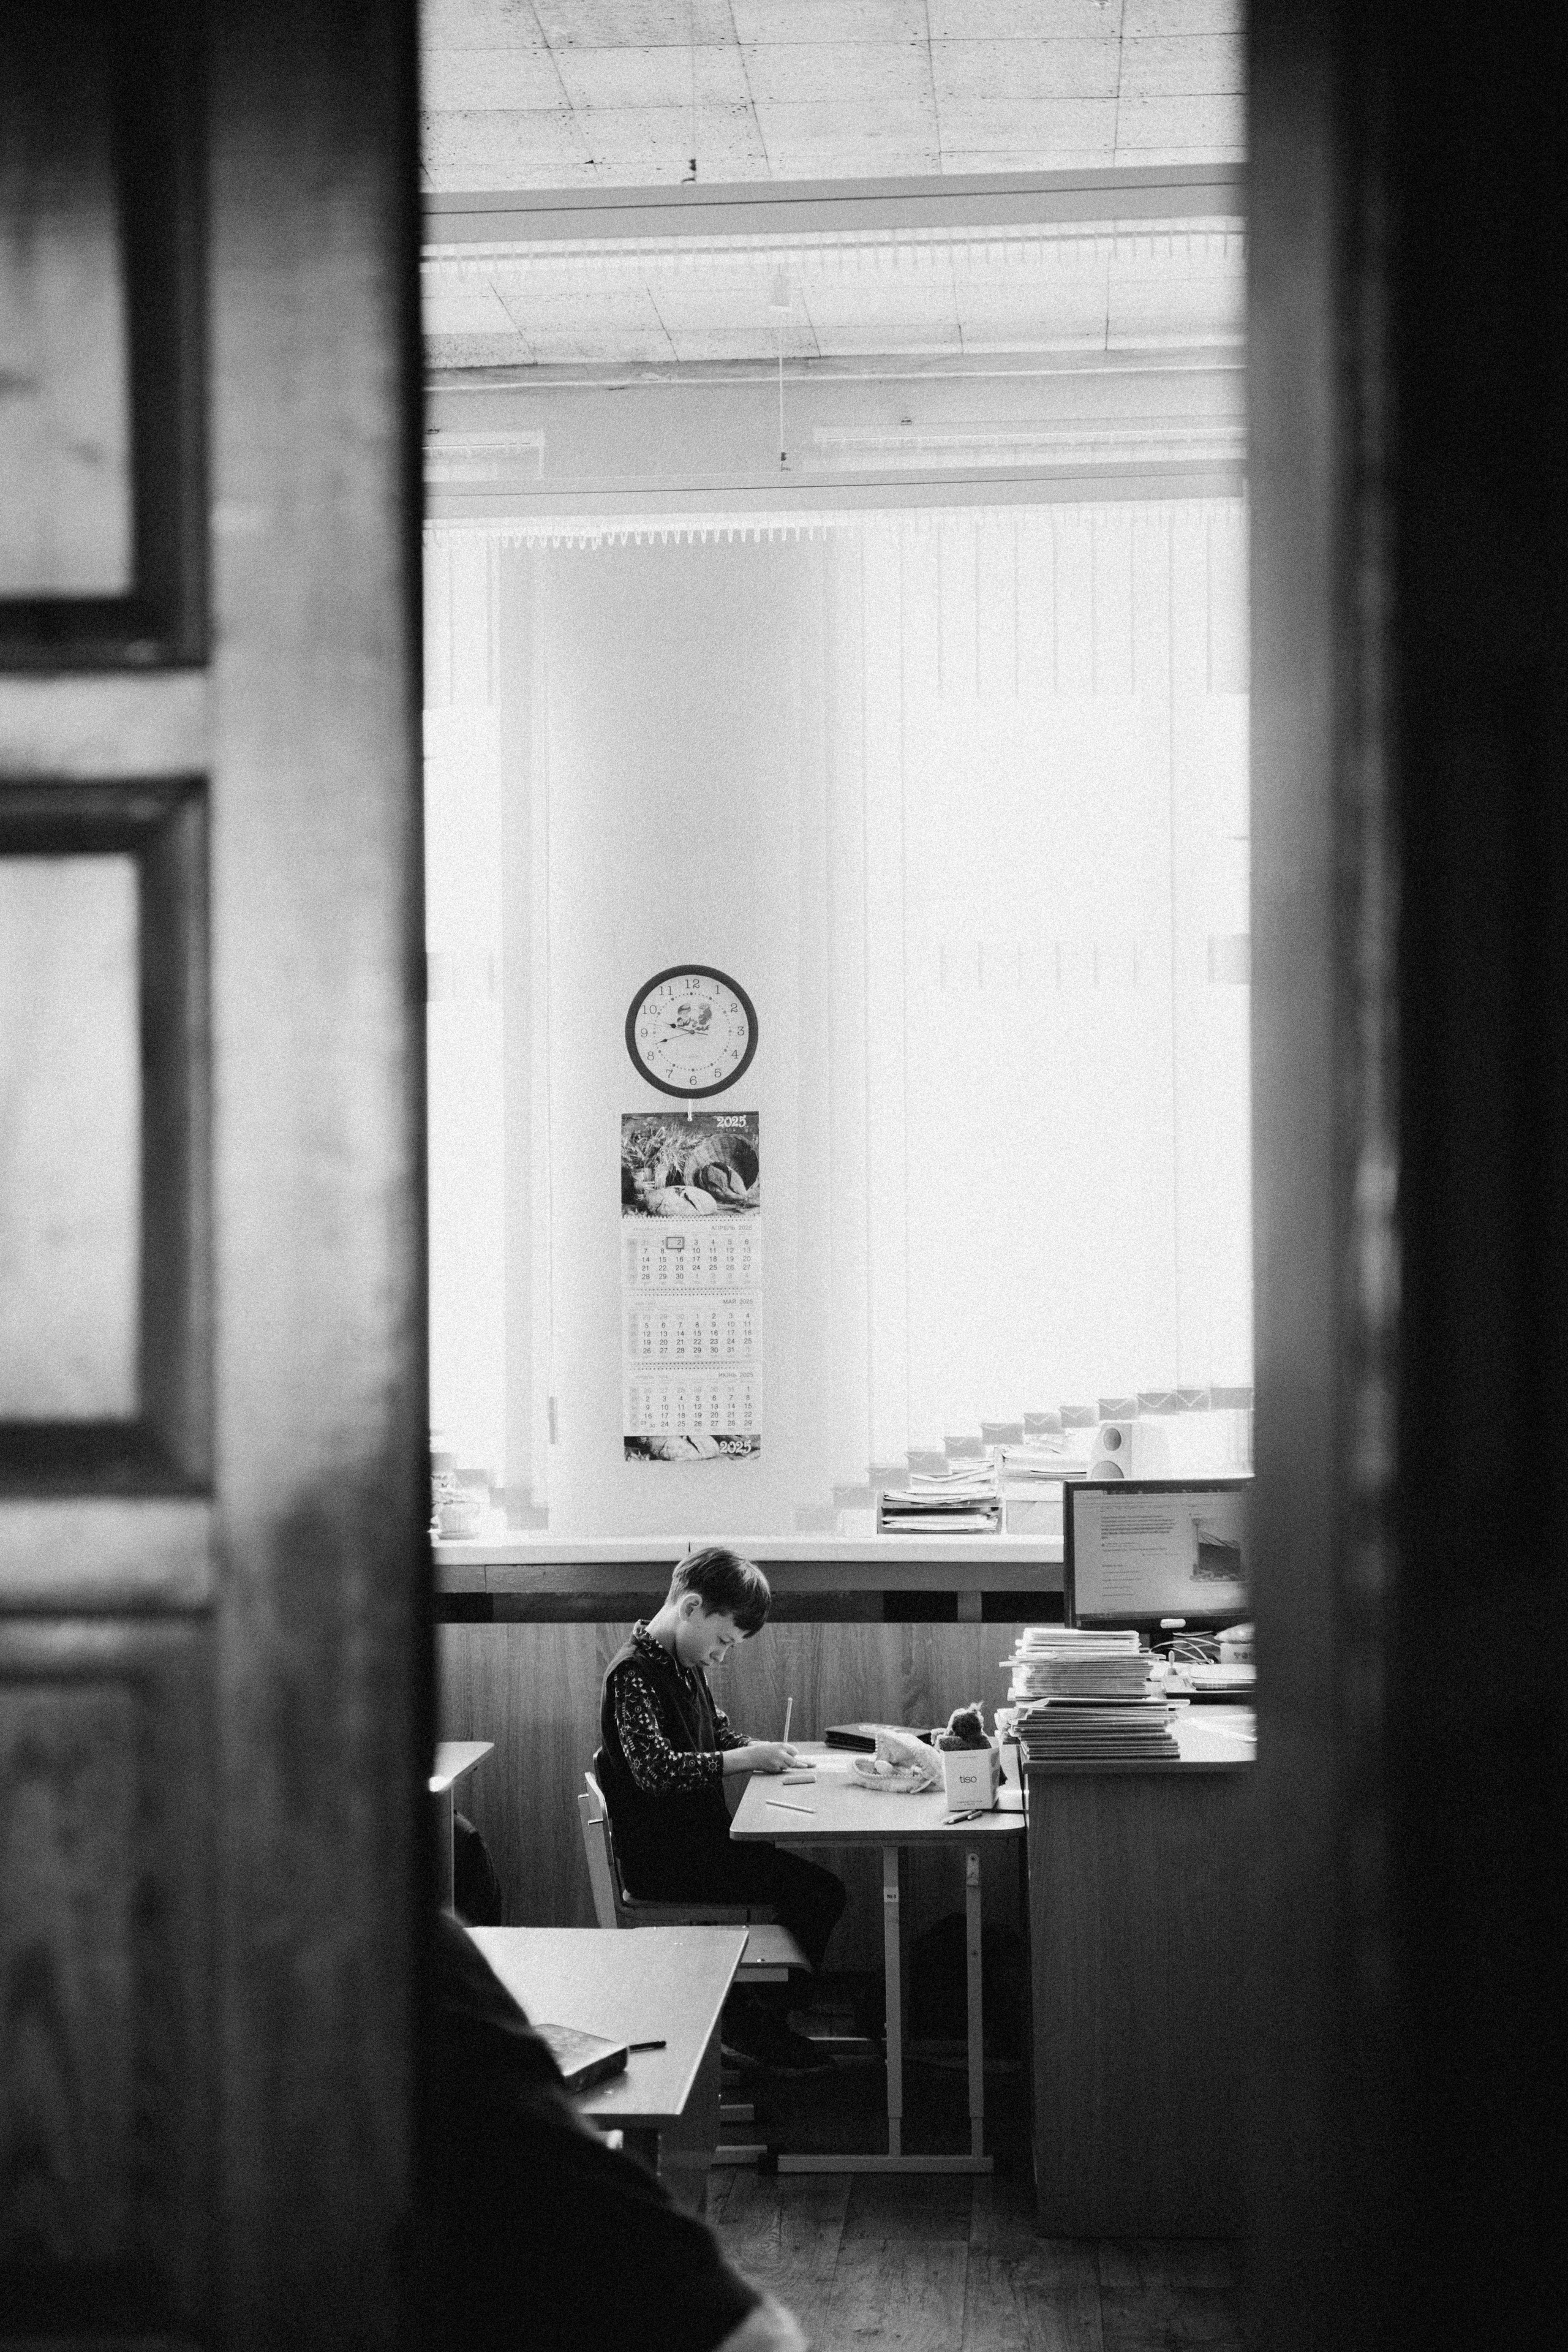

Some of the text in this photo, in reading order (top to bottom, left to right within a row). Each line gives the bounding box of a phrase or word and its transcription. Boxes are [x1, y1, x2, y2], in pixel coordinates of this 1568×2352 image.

[685, 979, 700, 989] 12
[659, 986, 673, 995] 11
[715, 985, 720, 995] 1
[642, 1005, 657, 1014] 10
[730, 1003, 739, 1013] 2
[641, 1028, 648, 1038] 9
[737, 1026, 745, 1036] 3
[647, 1052, 655, 1061] 8
[731, 1049, 739, 1059] 4
[666, 1069, 673, 1078] 7
[714, 1068, 722, 1078] 5
[690, 1076, 697, 1085] 6
[717, 1115, 747, 1128] 2025
[719, 1440, 752, 1453] 2025
